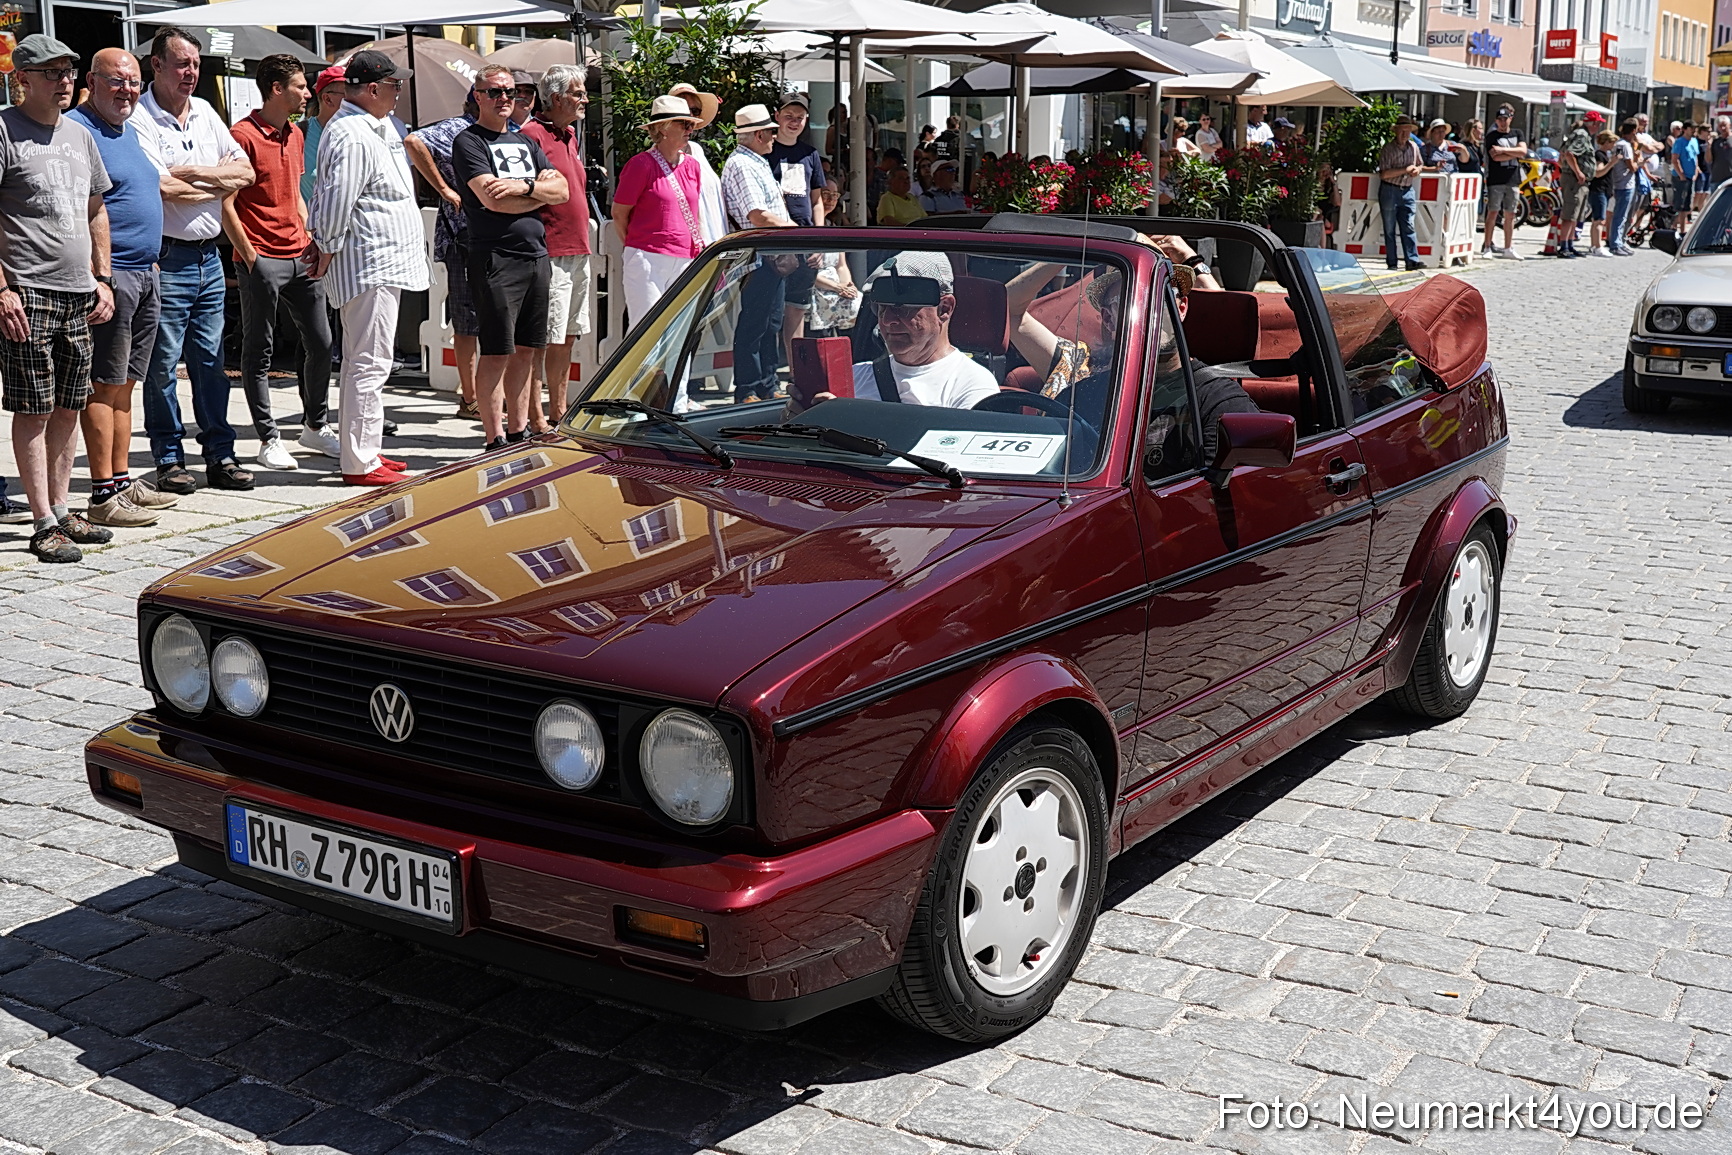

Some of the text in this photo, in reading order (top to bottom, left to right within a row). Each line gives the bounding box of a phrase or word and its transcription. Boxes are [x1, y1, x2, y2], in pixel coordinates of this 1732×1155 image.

[1549, 38, 1572, 48] WITT
[981, 439, 1033, 453] 476
[948, 775, 991, 861] BRAVURIS
[235, 840, 243, 854] D
[248, 815, 289, 871] RH
[432, 863, 449, 881] 04
[434, 898, 451, 915] 10
